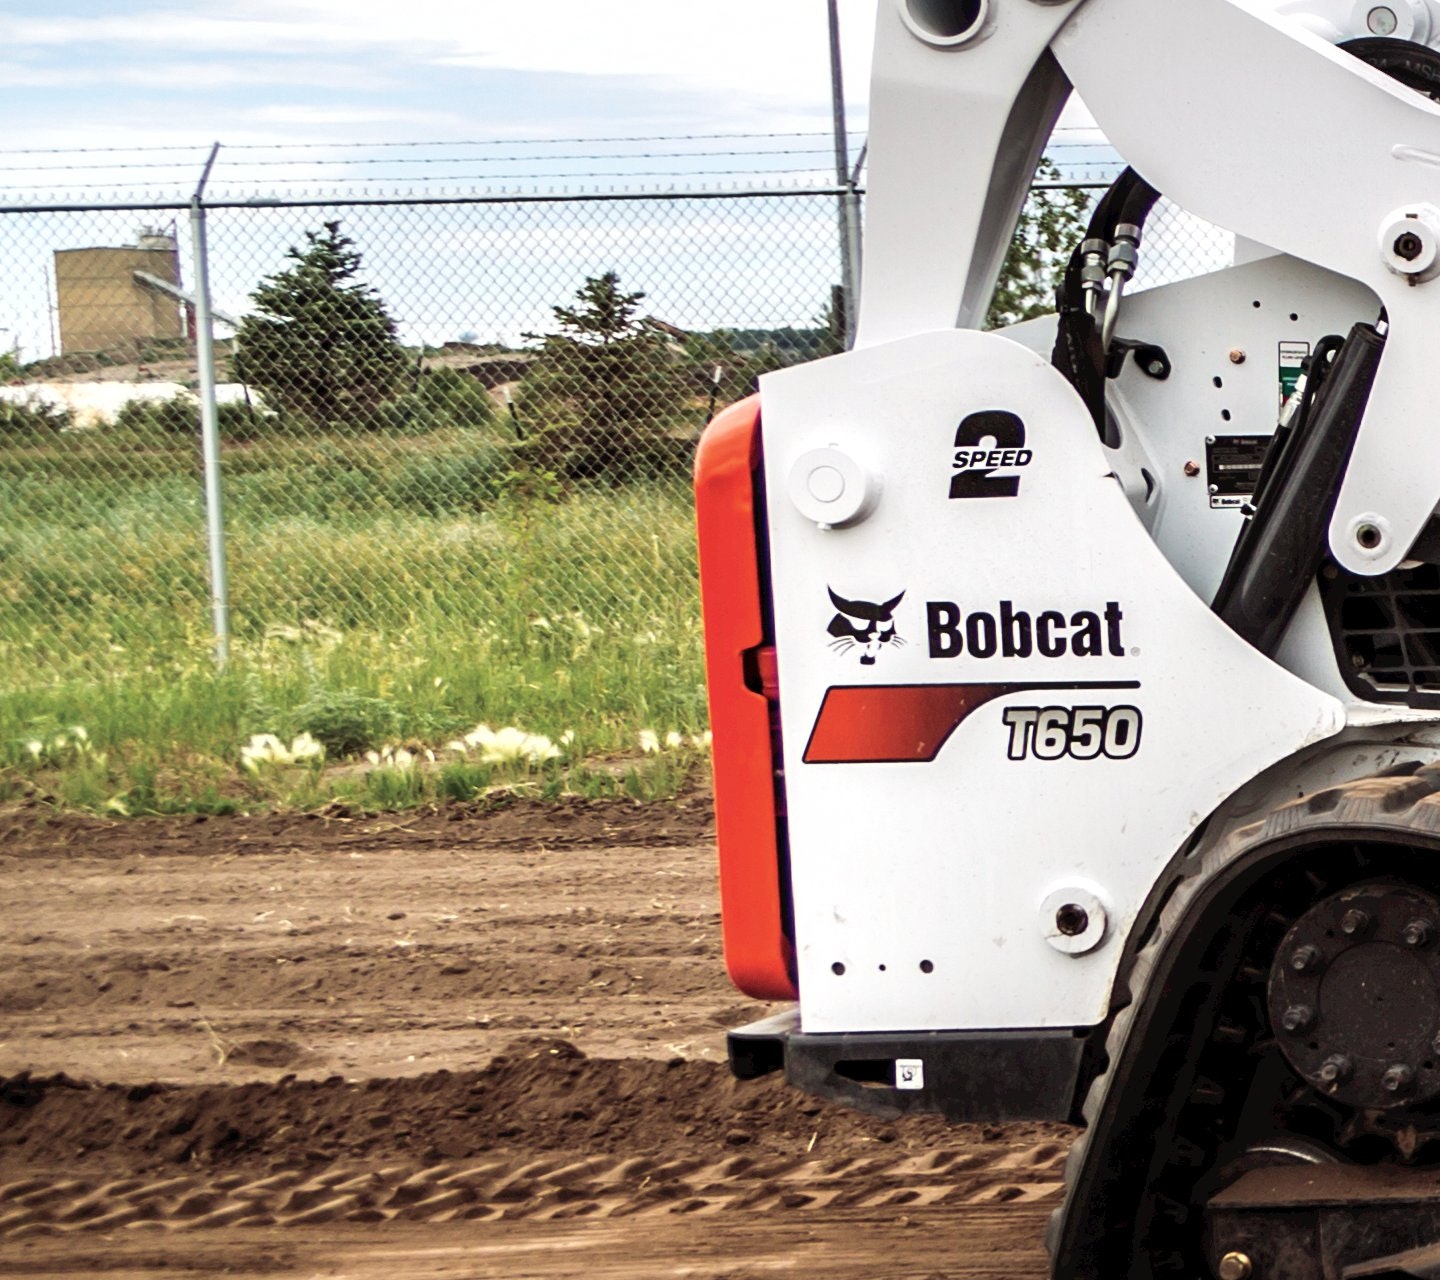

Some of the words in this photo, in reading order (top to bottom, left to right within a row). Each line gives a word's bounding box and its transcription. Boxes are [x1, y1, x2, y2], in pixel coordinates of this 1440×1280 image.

[948, 409, 1026, 499] 2
[952, 449, 1033, 468] SPEED
[926, 600, 1125, 658] Bobcat
[1002, 704, 1143, 760] T650
